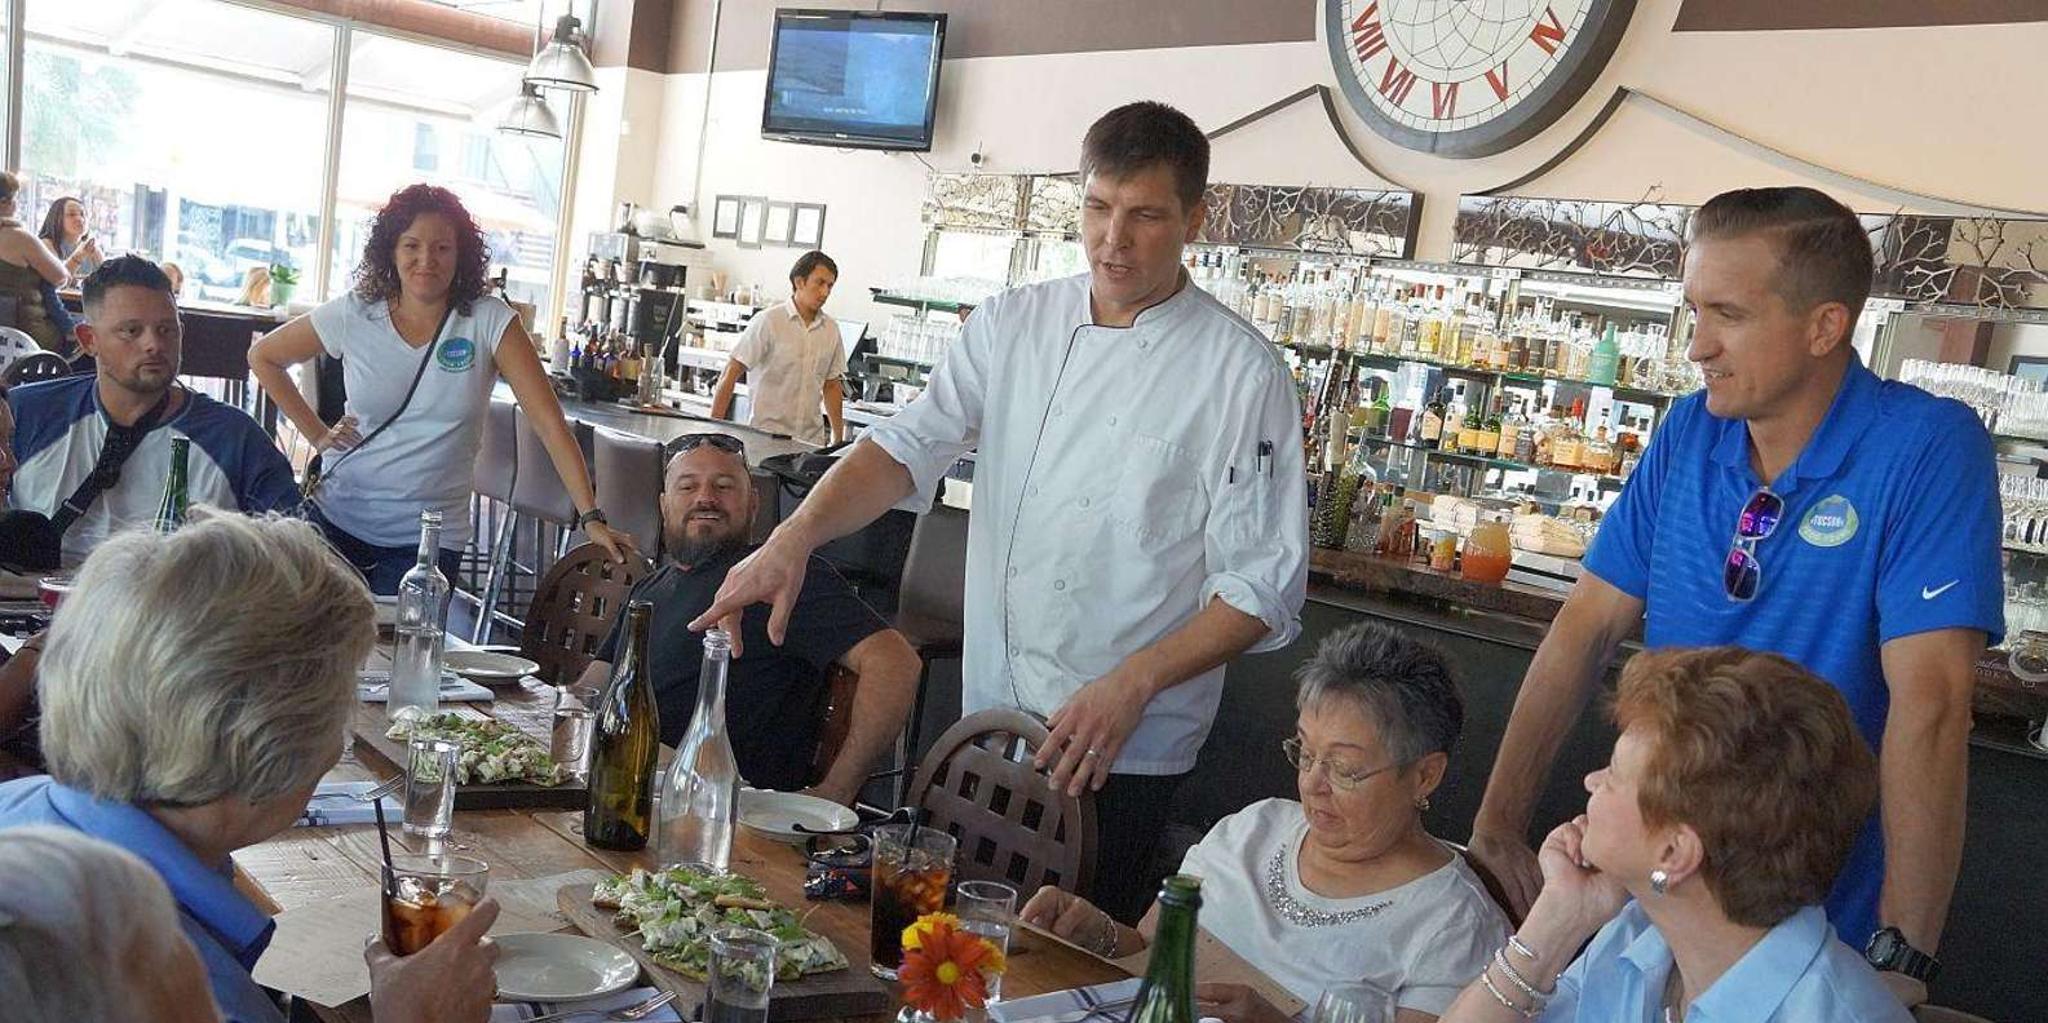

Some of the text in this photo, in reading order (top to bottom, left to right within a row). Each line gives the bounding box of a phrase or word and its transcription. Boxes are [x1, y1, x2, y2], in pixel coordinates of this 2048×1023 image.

[1378, 55, 1417, 106] VII
[1432, 82, 1459, 120] VI
[1485, 59, 1510, 101] V
